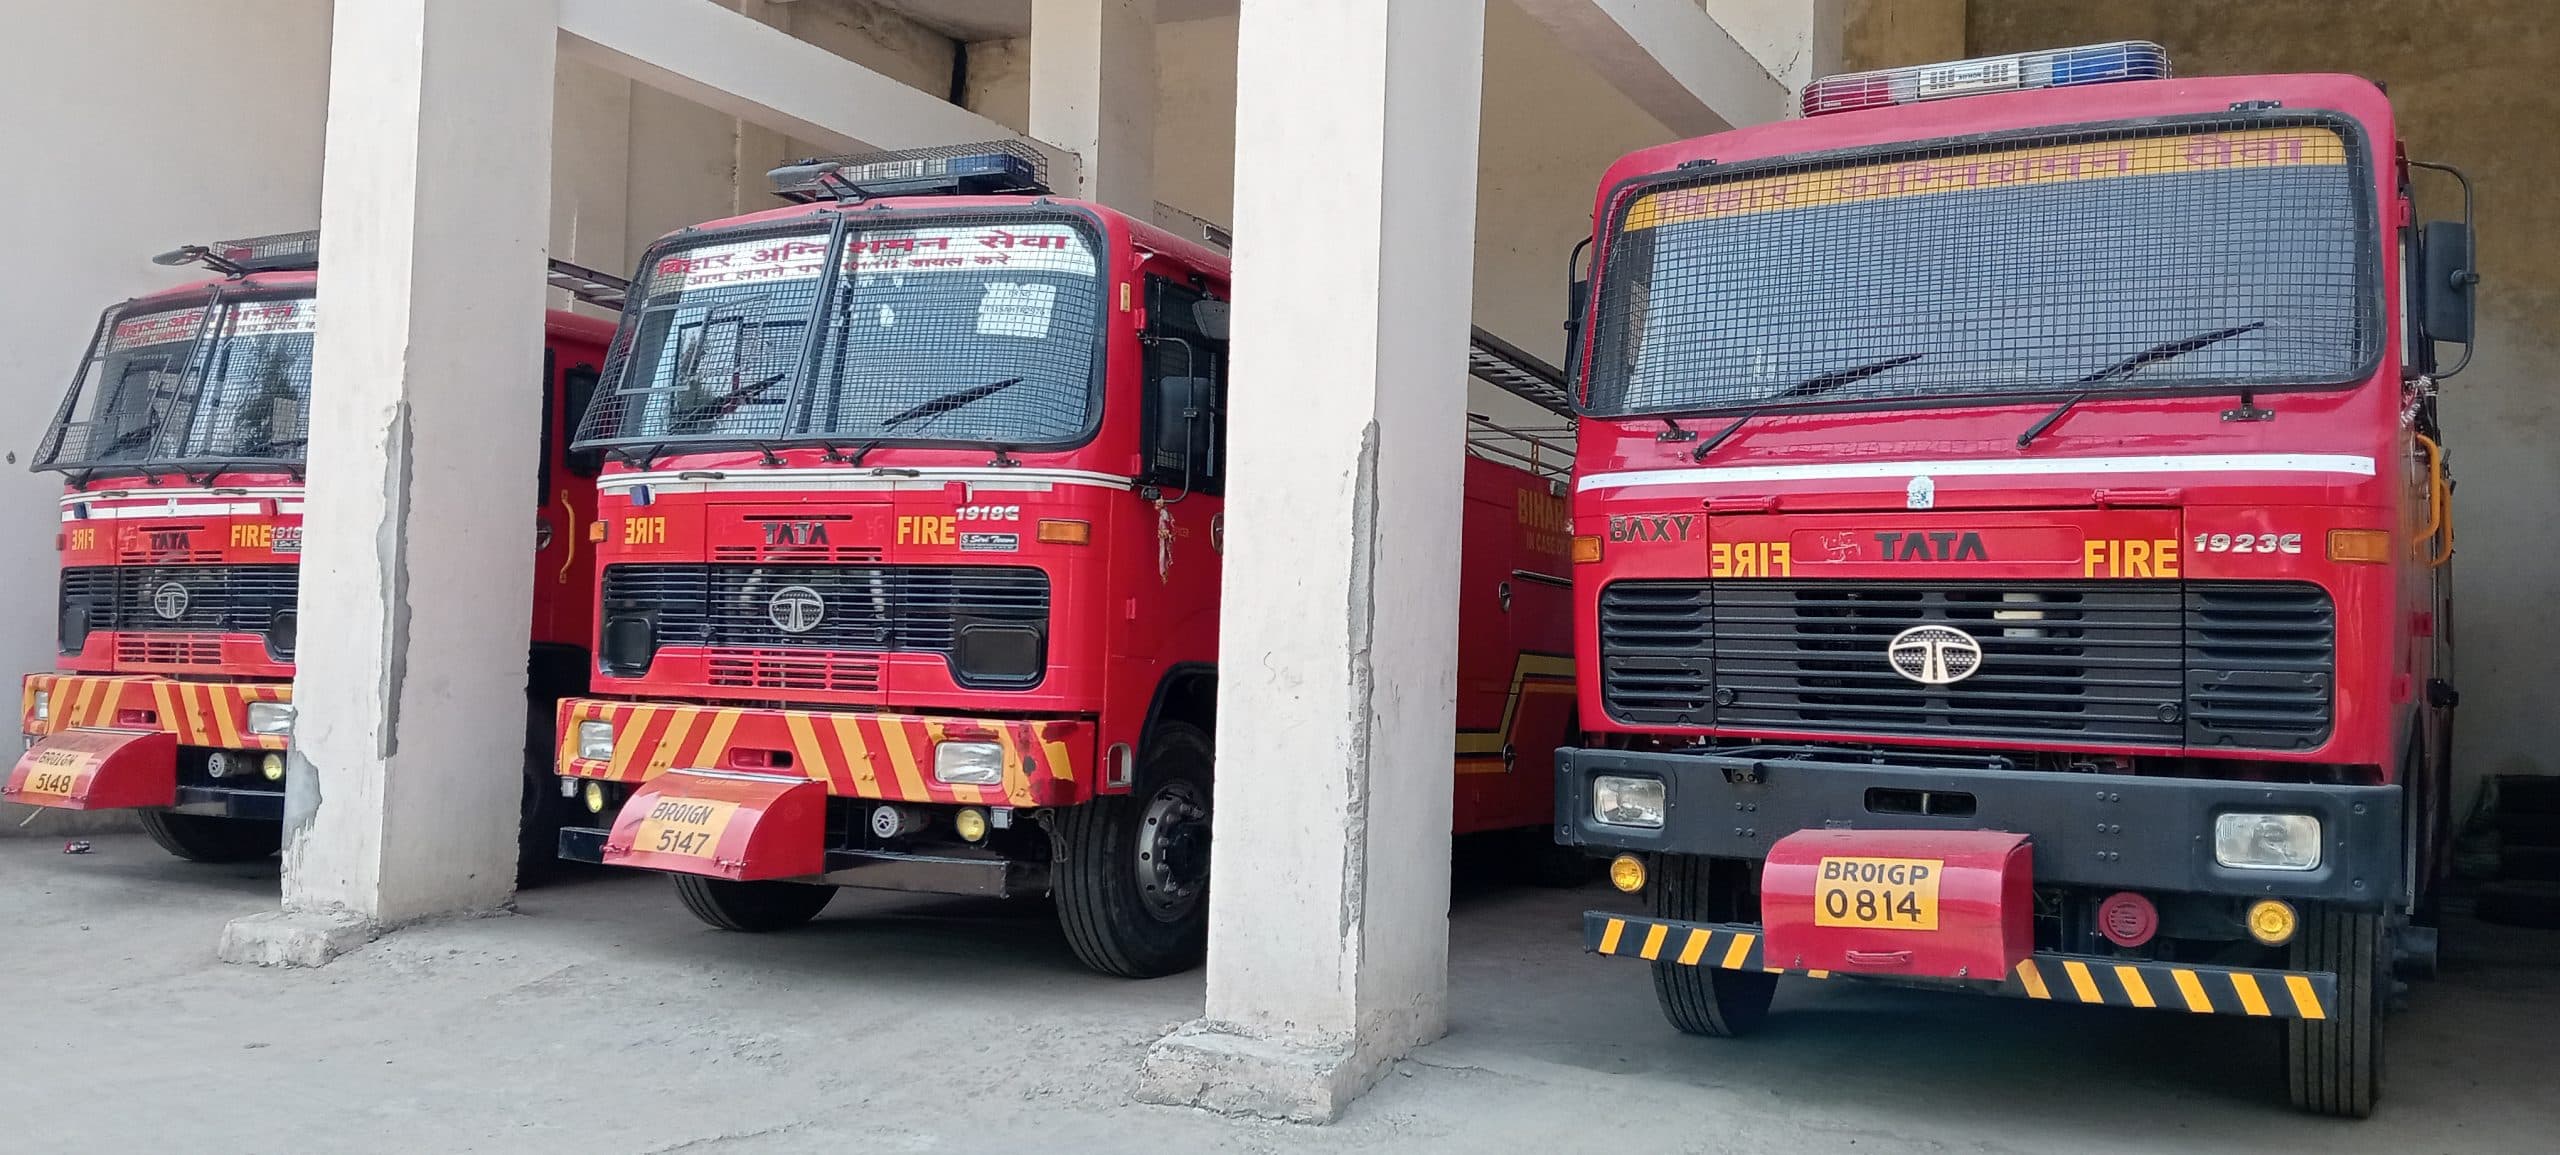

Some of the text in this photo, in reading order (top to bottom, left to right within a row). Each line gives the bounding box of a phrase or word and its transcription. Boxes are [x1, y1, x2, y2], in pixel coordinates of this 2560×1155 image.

[975, 230, 1069, 249] सेवा
[956, 505, 1019, 521] 1918C
[151, 532, 190, 549] TATA
[231, 525, 272, 547] FIRE
[761, 521, 829, 544] TATA
[897, 516, 956, 545] FIRE
[1874, 532, 1989, 561] TATA
[2193, 532, 2302, 554] 1923C
[2085, 539, 2179, 578] FIRE
[36, 773, 71, 793] 5148
[656, 829, 711, 855] 5147
[1824, 861, 1930, 886] BR01GP
[1825, 888, 1922, 922] 0814
